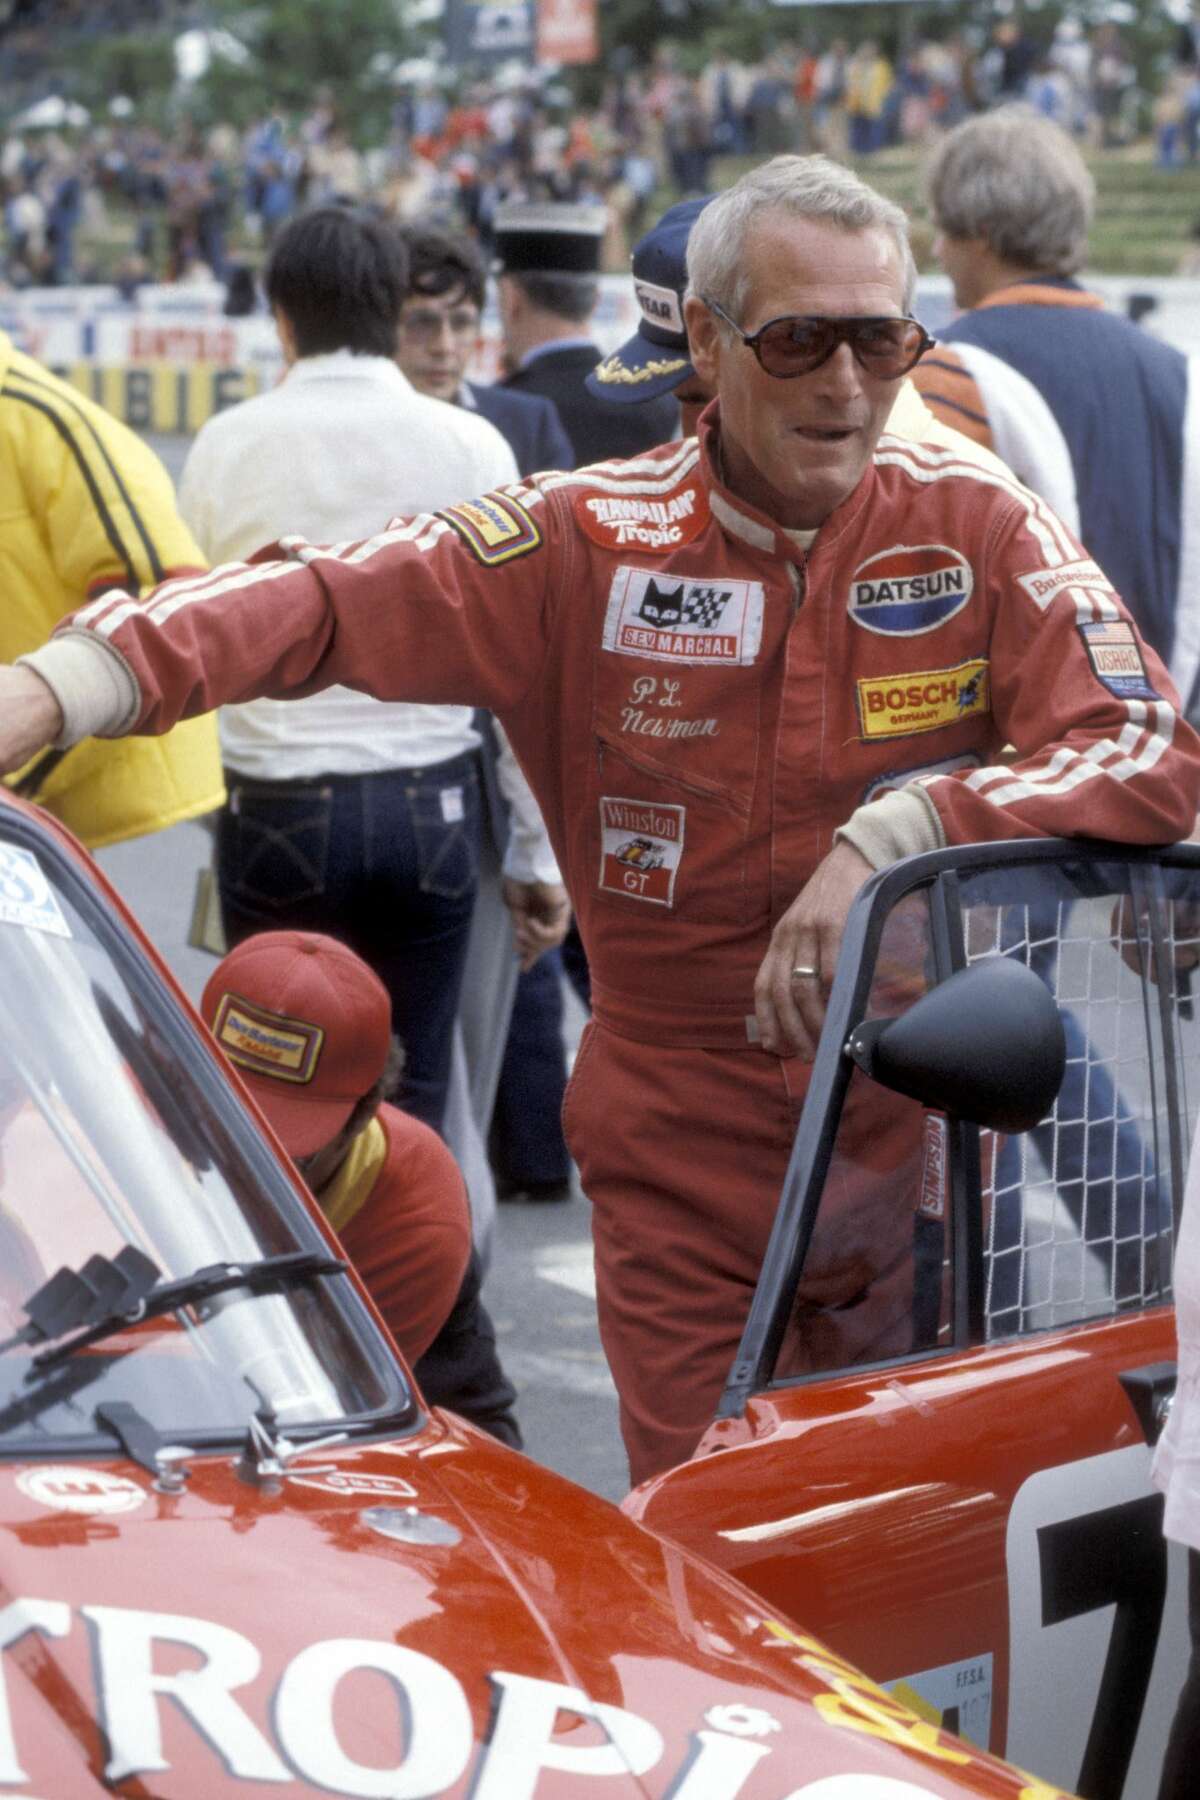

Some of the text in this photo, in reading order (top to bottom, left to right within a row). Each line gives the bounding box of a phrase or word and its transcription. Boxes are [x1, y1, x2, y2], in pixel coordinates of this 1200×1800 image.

[602, 520, 683, 548] Tropic
[856, 569, 963, 605] DATSUN
[656, 633, 734, 656] MARCHAL
[866, 681, 957, 713] BOSCH
[621, 707, 720, 738] Newman
[890, 709, 940, 725] GERMANY
[607, 803, 676, 838] Winston
[623, 870, 651, 894] GT
[925, 1118, 942, 1211] SIMPSON
